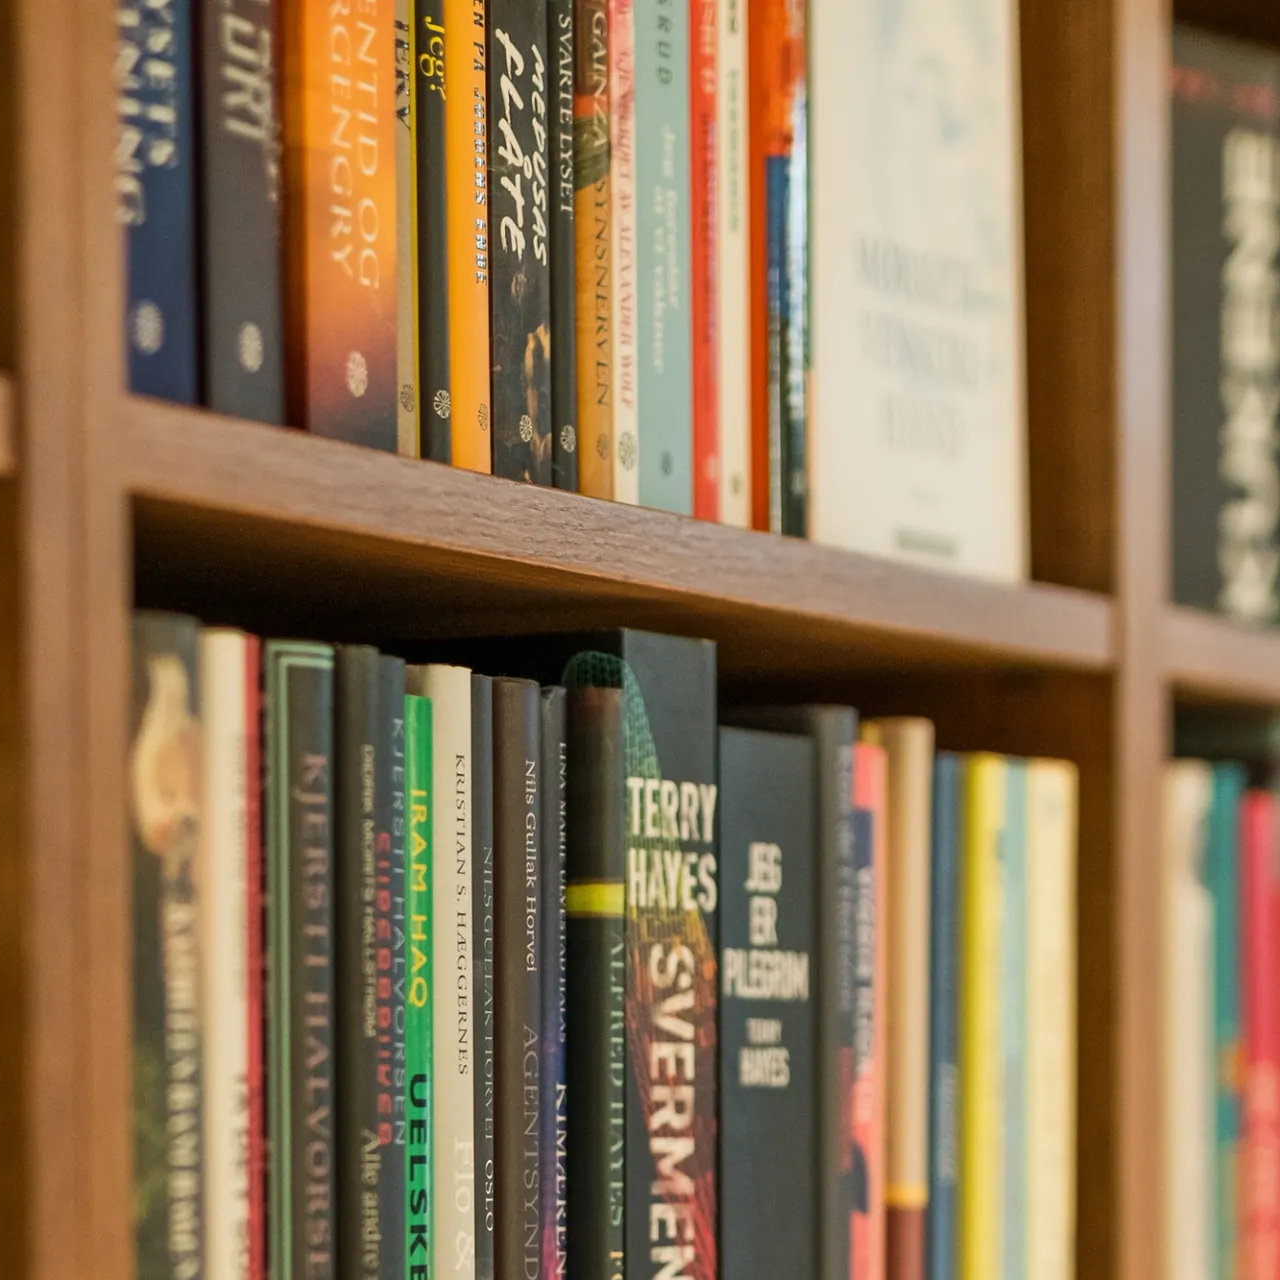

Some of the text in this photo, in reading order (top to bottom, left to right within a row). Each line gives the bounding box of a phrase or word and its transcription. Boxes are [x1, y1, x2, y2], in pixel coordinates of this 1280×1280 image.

[419, 15, 446, 101] Jeg?
[584, 11, 609, 148] GAINZA
[656, 0, 674, 86] RUD
[473, 87, 487, 207] JORDENS
[494, 28, 533, 263] FLÅTE
[530, 43, 547, 266] MEDUSAS
[558, 13, 574, 220] SVARTE LYSET
[357, 196, 380, 290] OG
[474, 218, 488, 287] ENDE
[593, 177, 610, 405] SYNSNERVEN
[294, 752, 330, 968] KJERSTI
[625, 776, 717, 843] TERRY
[407, 788, 428, 1009] IRAM HAQ
[454, 753, 470, 1076] KRISTIAN S. HÆGGERNES
[524, 758, 538, 972] Nils Gullak Horvei
[627, 847, 718, 913] HAYES
[743, 842, 783, 890] JEG
[391, 717, 406, 1145] KJERSTI HALVORSEN
[722, 947, 811, 1000] PILEGRIM
[748, 896, 779, 946] ER
[482, 845, 495, 1232] NILS GULLAK HORVEI OSLO
[609, 934, 625, 1088] ALFRED
[738, 1046, 791, 1088] HAYES
[360, 1129, 382, 1185] Alle
[453, 1136, 473, 1214] Flo
[609, 1101, 625, 1227] HAYES
[361, 1190, 383, 1269] andre
[454, 1229, 475, 1272] &
